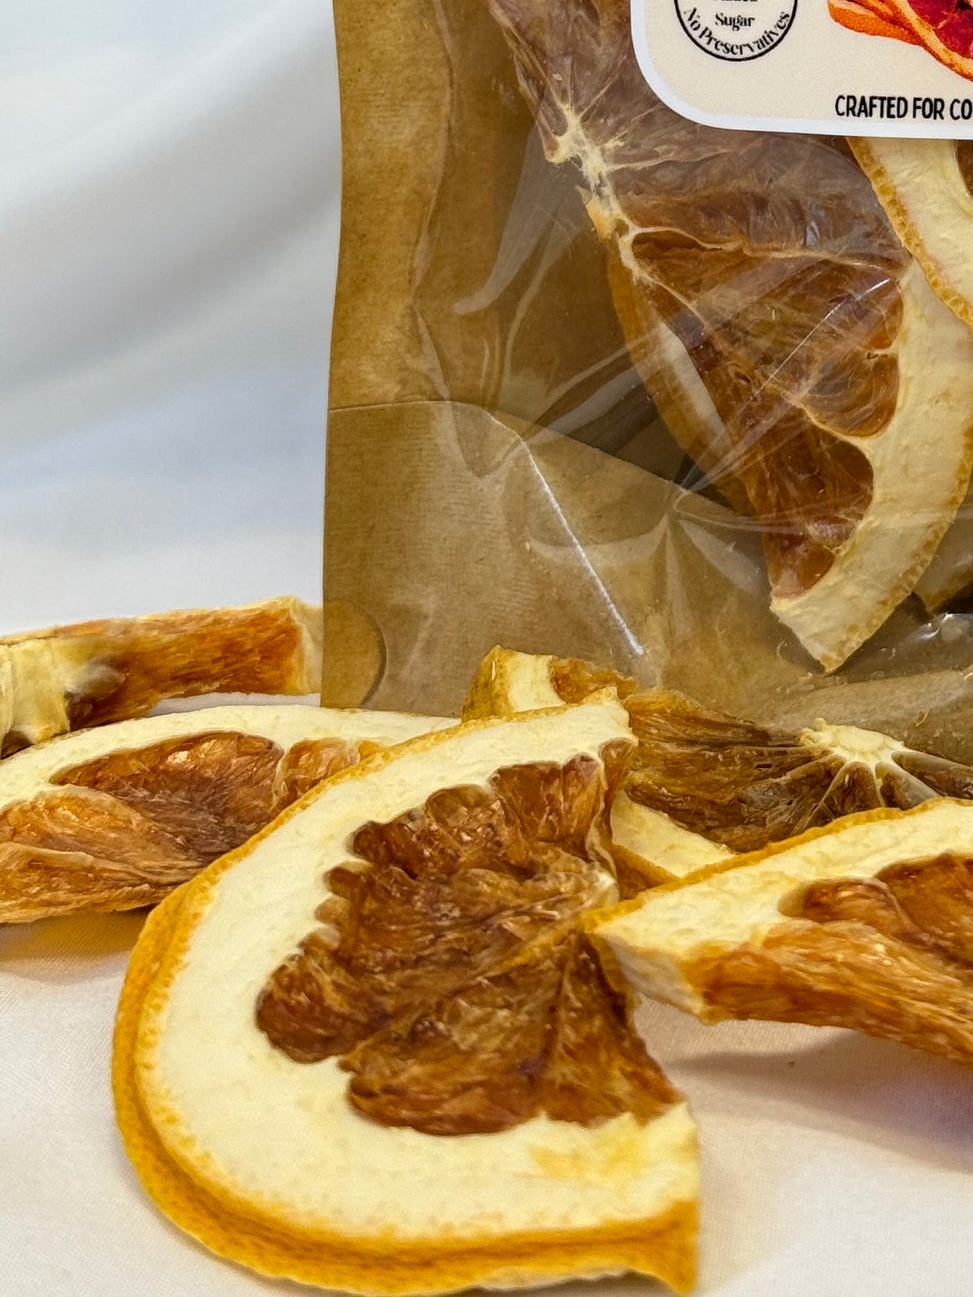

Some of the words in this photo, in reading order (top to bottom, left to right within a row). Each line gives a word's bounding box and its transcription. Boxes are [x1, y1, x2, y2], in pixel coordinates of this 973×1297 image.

[683, 7, 702, 31] No
[698, 11, 790, 55] Preservatives
[714, 12, 755, 31] Sugar
[835, 94, 908, 118] CRAFTED
[912, 97, 945, 120] FOR
